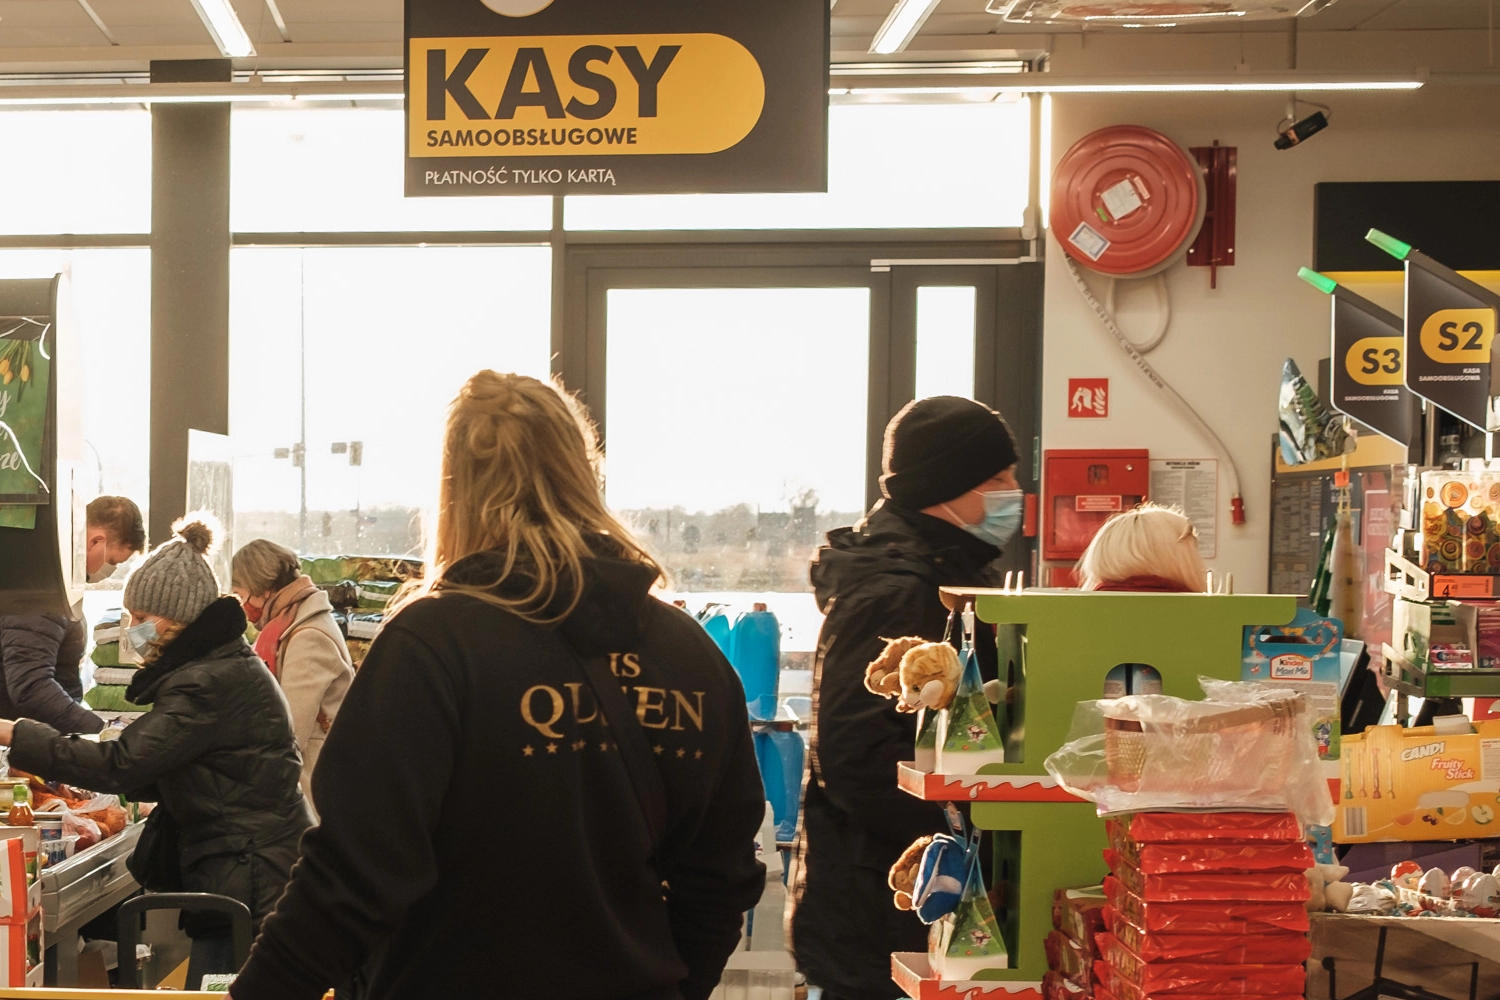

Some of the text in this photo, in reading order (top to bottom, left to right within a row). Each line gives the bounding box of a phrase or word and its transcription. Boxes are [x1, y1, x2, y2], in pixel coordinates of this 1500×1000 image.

[426, 44, 683, 121] KASY
[427, 127, 637, 148] SAMOOBSŁUGOWE
[425, 166, 617, 186] PŁATNOŚĆ TYLKO KARTĄ
[1438, 322, 1483, 351] S2
[1361, 348, 1400, 374] S3
[1279, 658, 1304, 666] kinder
[520, 682, 706, 739] QUEN
[1431, 758, 1464, 771] Fruity
[1445, 769, 1475, 780] Stick
